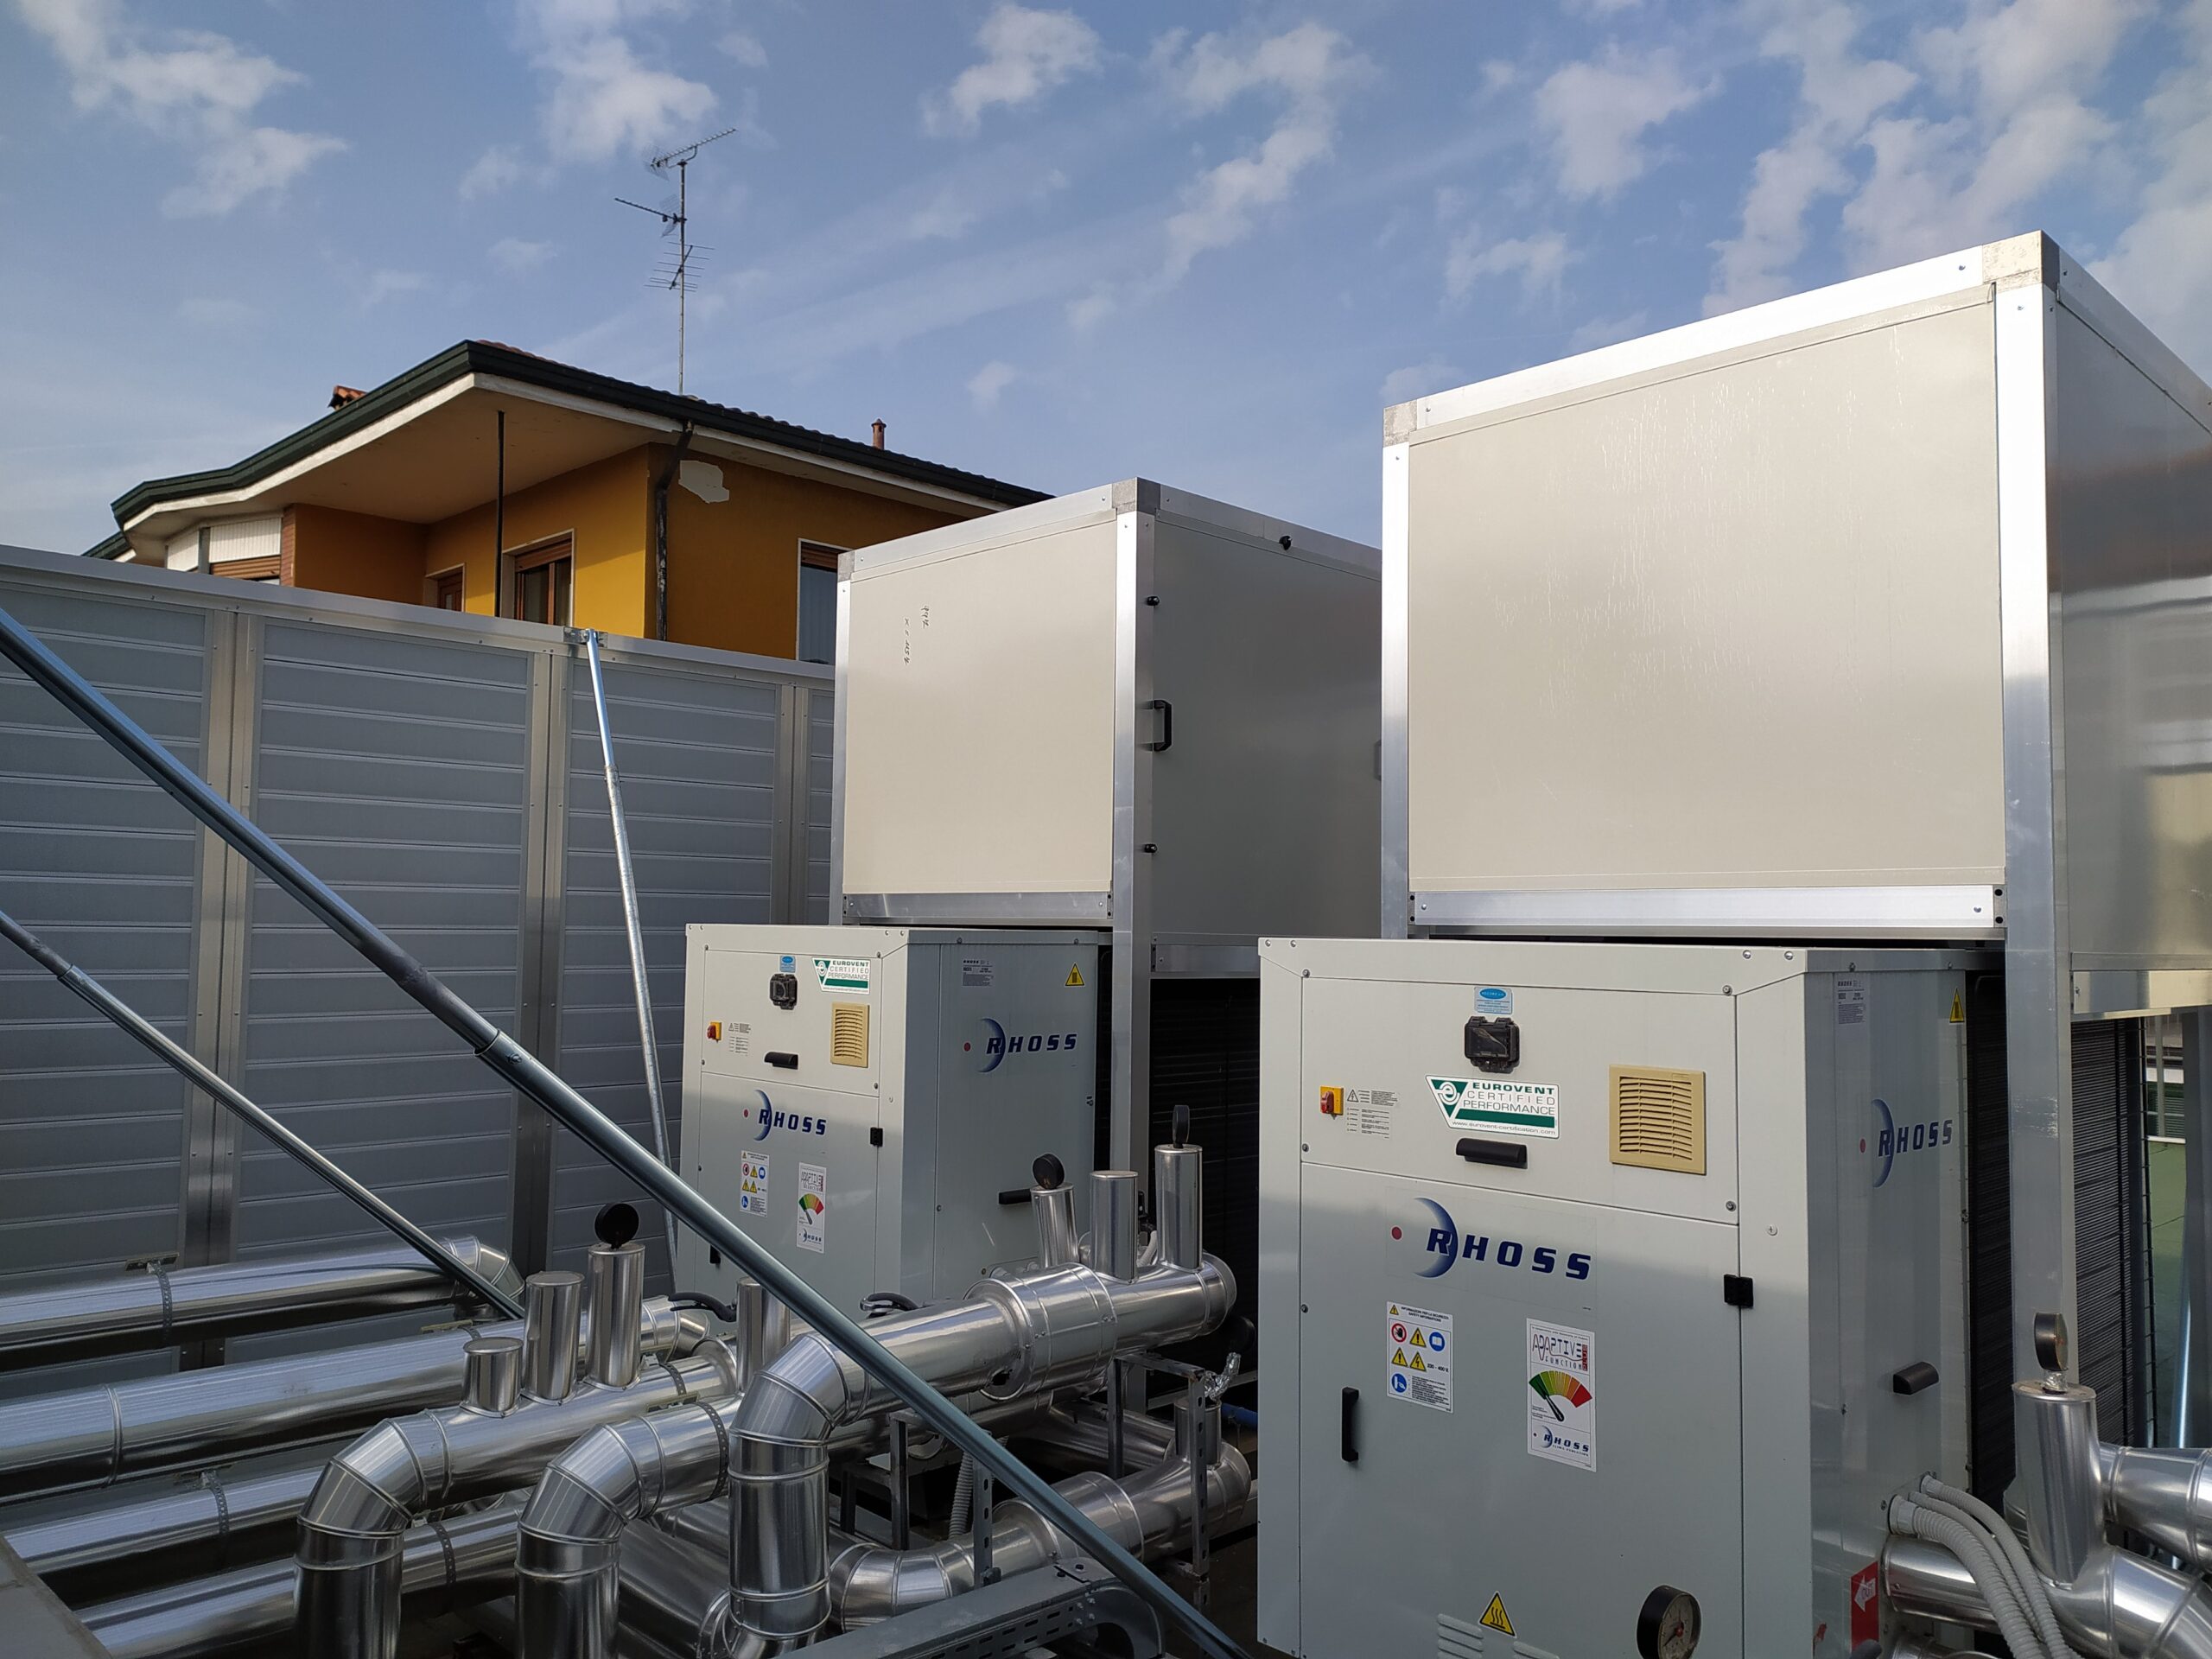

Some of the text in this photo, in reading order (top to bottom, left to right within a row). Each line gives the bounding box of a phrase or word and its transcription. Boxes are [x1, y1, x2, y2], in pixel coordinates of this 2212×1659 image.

[986, 1033, 1077, 1054] RHOSS
[1467, 1090, 1555, 1106] CERTIFIED
[1472, 1082, 1554, 1095] EUROVENT
[1463, 1100, 1555, 1116] PERFORMANCE
[758, 1108, 827, 1135] RHOSS
[1452, 1121, 1556, 1135] www.eurovent-certification.com
[1878, 1119, 1953, 1157] RHOSS
[1426, 1227, 1592, 1281] RHOSS
[1532, 1334, 1582, 1358] ADAPTIVE
[1546, 1356, 1582, 1370] FUNCTION
[1543, 1433, 1590, 1452] RHOSS
